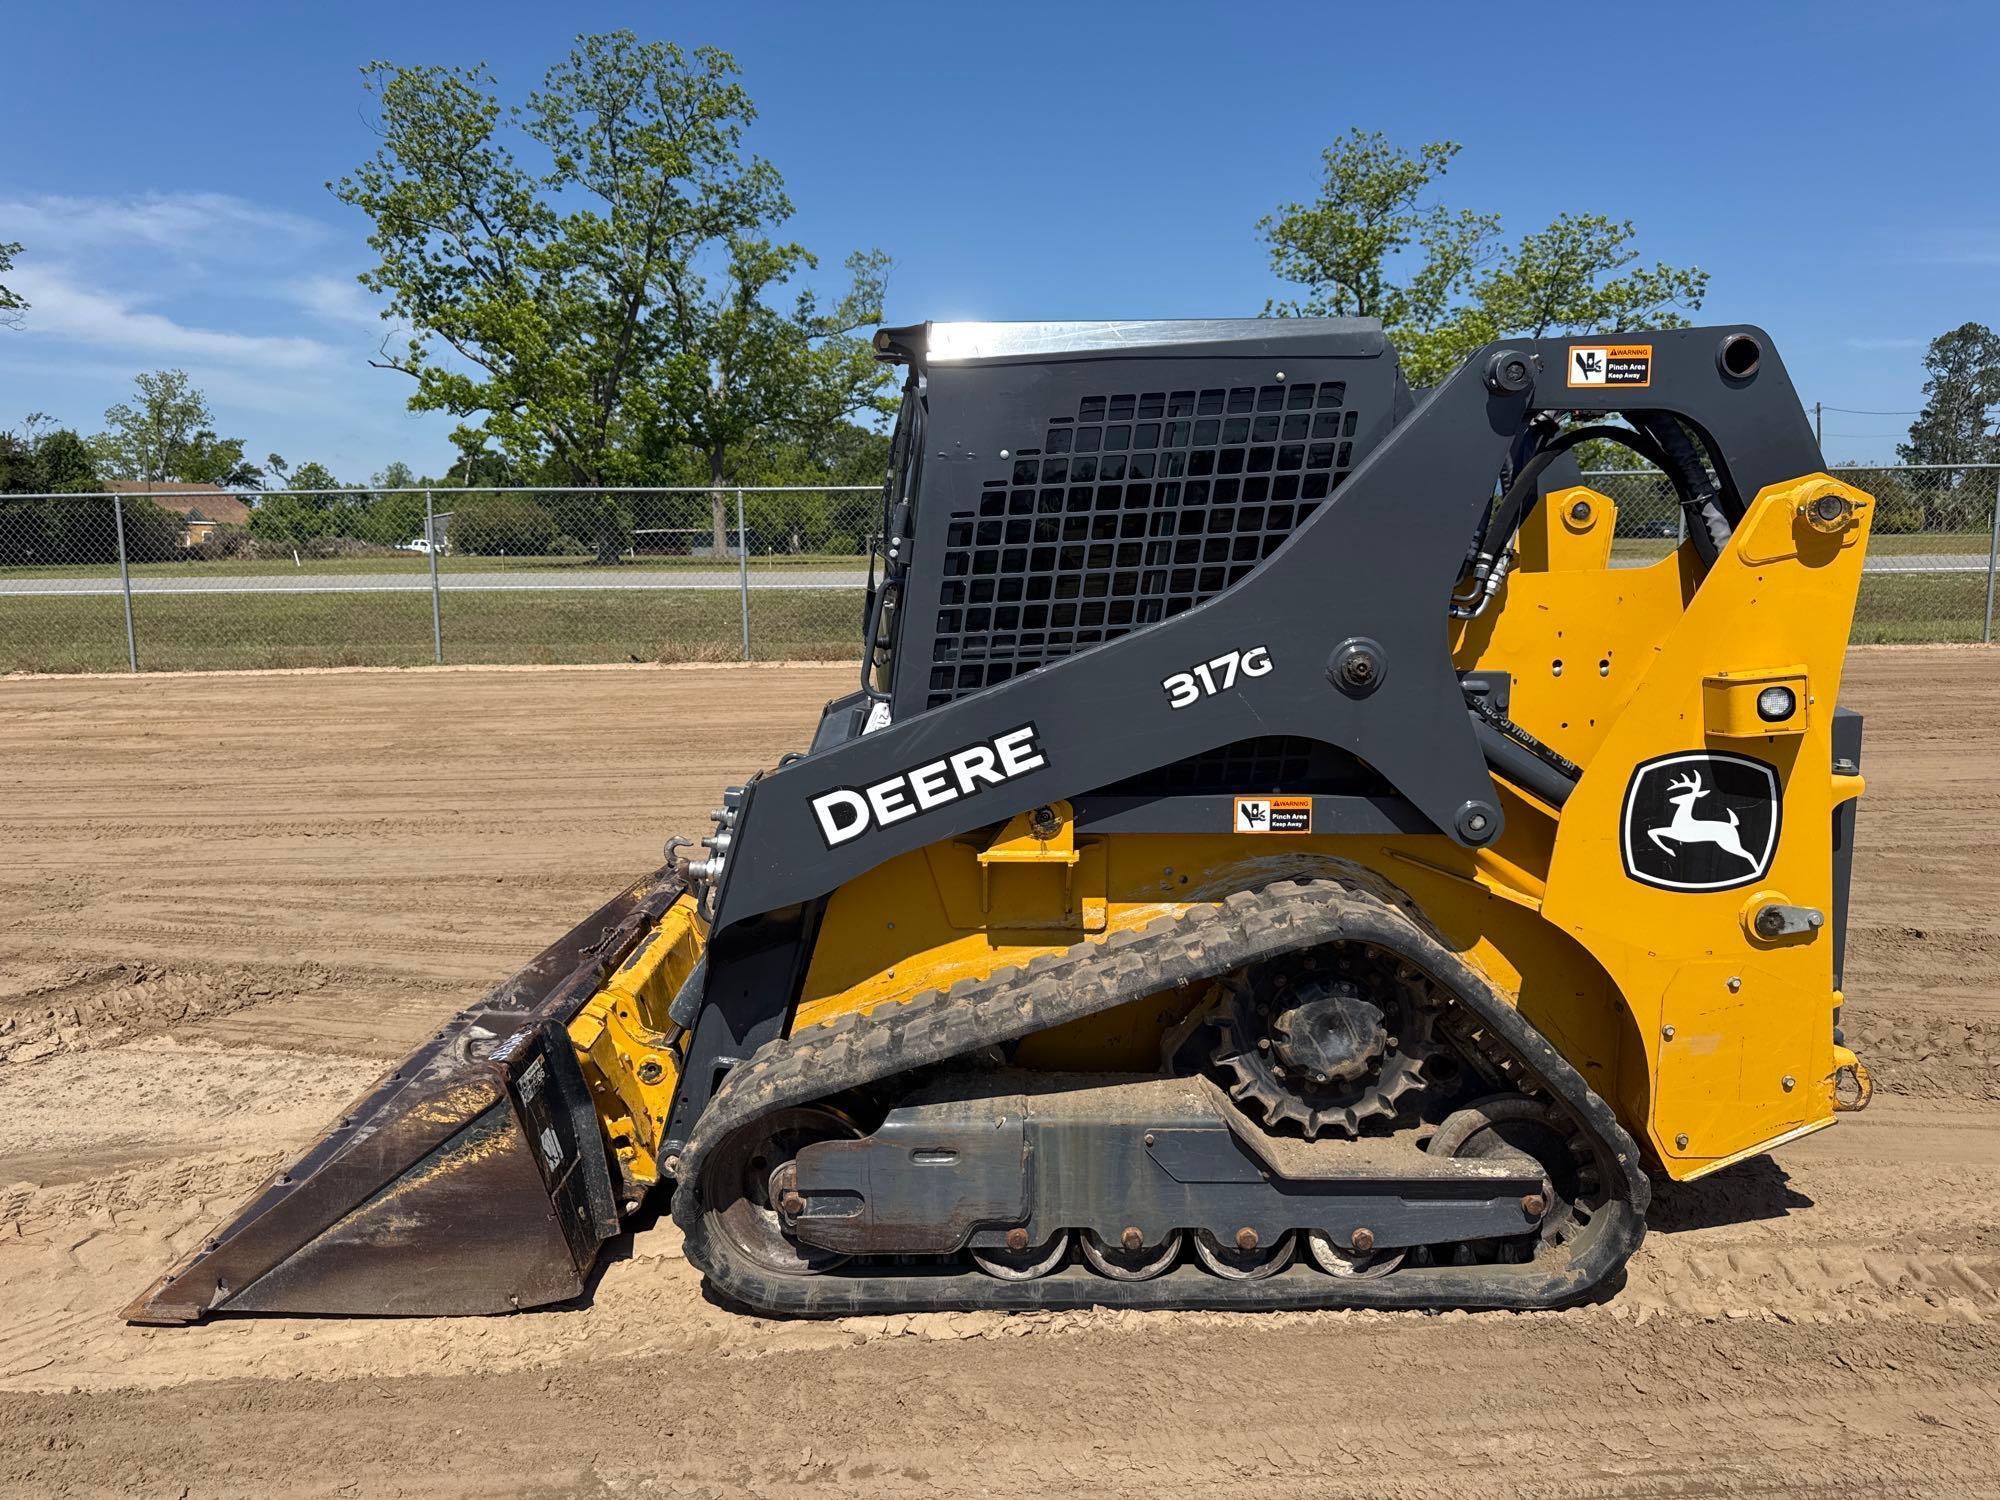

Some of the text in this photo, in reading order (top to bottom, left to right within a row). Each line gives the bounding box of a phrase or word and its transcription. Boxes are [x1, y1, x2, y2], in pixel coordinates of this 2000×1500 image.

[1608, 363, 1646, 371] Pinch Area
[1162, 645, 1275, 709] 317G
[811, 724, 1046, 848] DEERE
